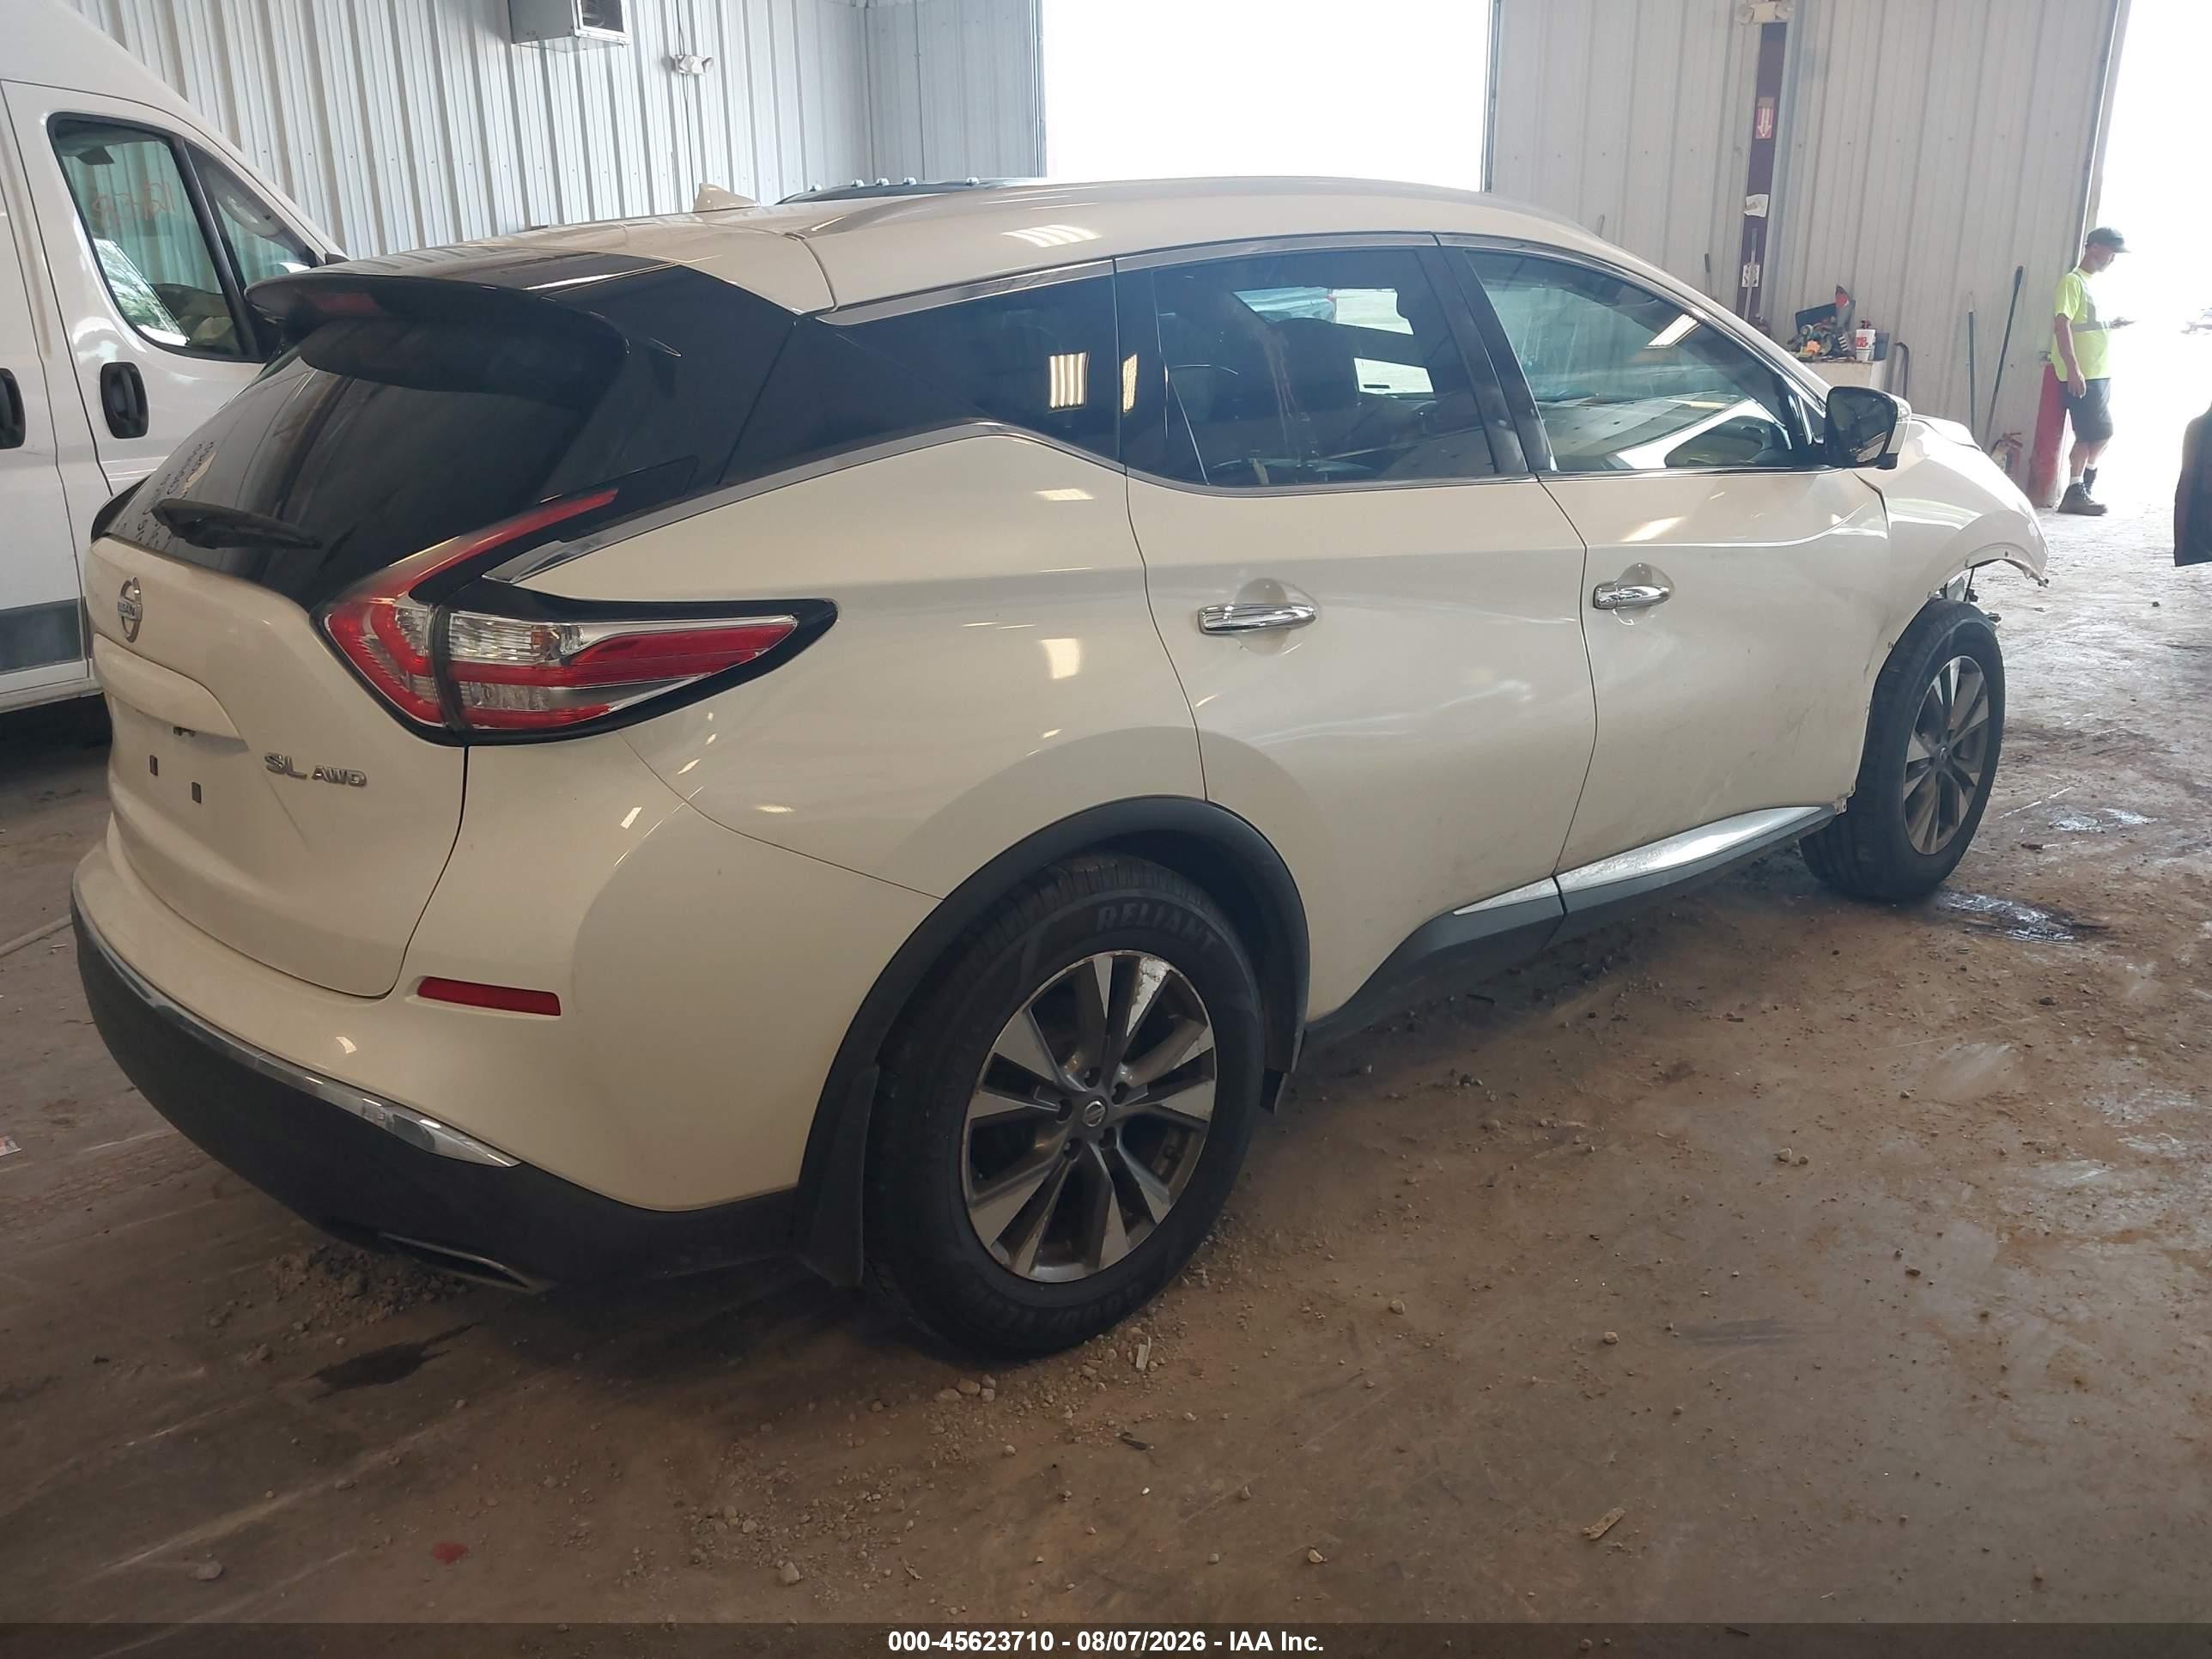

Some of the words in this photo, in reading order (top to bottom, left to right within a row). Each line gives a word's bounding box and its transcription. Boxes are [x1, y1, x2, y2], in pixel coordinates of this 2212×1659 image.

[264, 752, 307, 780] SL
[312, 765, 367, 787] AWD
[1096, 902, 1220, 954] RELIANT
